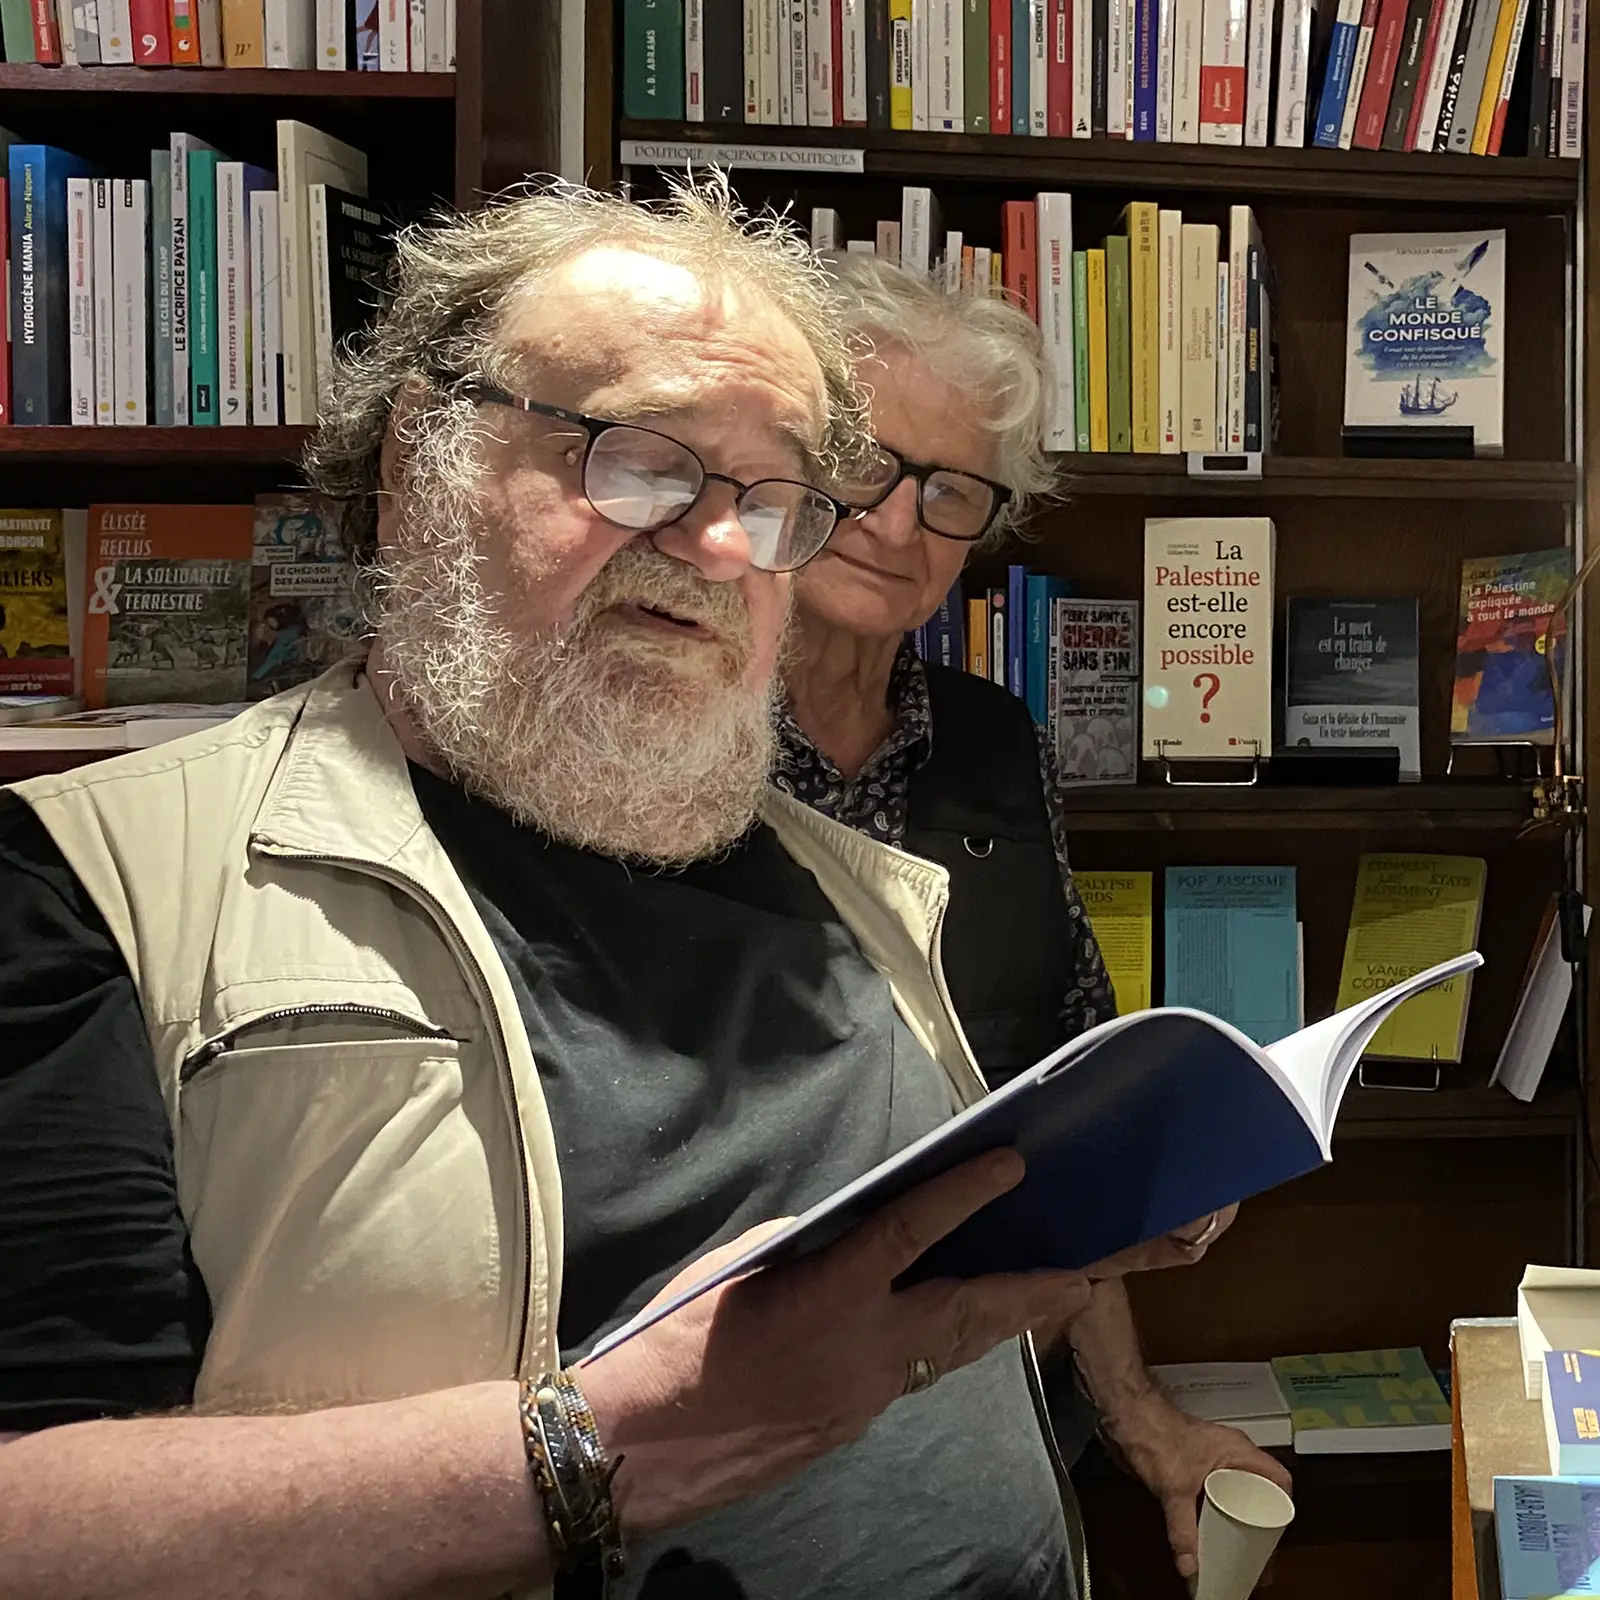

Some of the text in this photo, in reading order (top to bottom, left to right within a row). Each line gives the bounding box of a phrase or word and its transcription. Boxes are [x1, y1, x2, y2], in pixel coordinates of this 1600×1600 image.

[1035, 4, 1044, 43] CHOMSKY
[646, 30, 656, 70] ABRAMS
[1438, 72, 1461, 136] laïcité
[1566, 111, 1578, 140] DOCTRINE
[634, 145, 856, 166] POLITIQUE SCIENCES POLITIQUES
[23, 233, 34, 272] MANIA
[1049, 239, 1060, 266] LIBERTÉ
[1052, 266, 1060, 276] LA
[1052, 276, 1061, 286] DE
[158, 246, 170, 337] LES CLÉS DU CHAMP
[174, 217, 186, 352] LE SACRIFICE PAYSAN
[227, 267, 236, 322] TERRESTRES
[1415, 296, 1437, 309] LE
[1388, 311, 1462, 325] MONDE
[1368, 323, 1481, 341] CONFISQUÉ
[227, 324, 237, 390] PERSPECTIVES
[100, 509, 147, 531] ÉLISÉE
[100, 539, 152, 556] RECLUS
[1215, 540, 1243, 560] La
[125, 563, 232, 584] LA SOLIDARITÉ
[275, 566, 286, 575] LE
[1155, 566, 1261, 586] Palestine
[87, 566, 122, 614] &
[274, 576, 339, 586] DES ANIMAUX
[1468, 578, 1536, 597] La Palestine
[124, 593, 204, 610] TERRESTRE
[1166, 592, 1248, 613] est-elle
[1467, 594, 1522, 612] expliquée
[1466, 602, 1555, 623] à tout le monde
[1168, 622, 1247, 639] encore
[1334, 616, 1346, 635] La
[1062, 624, 1129, 649] GUERRE
[1318, 635, 1388, 652] est en train de
[1062, 651, 1131, 671] SANS FIN
[1160, 644, 1254, 670] possible
[1334, 653, 1373, 673] changer
[10, 681, 43, 692] arte
[1193, 672, 1220, 723] ?
[1361, 713, 1369, 724] de
[1177, 875, 1289, 887] POP FASCISME
